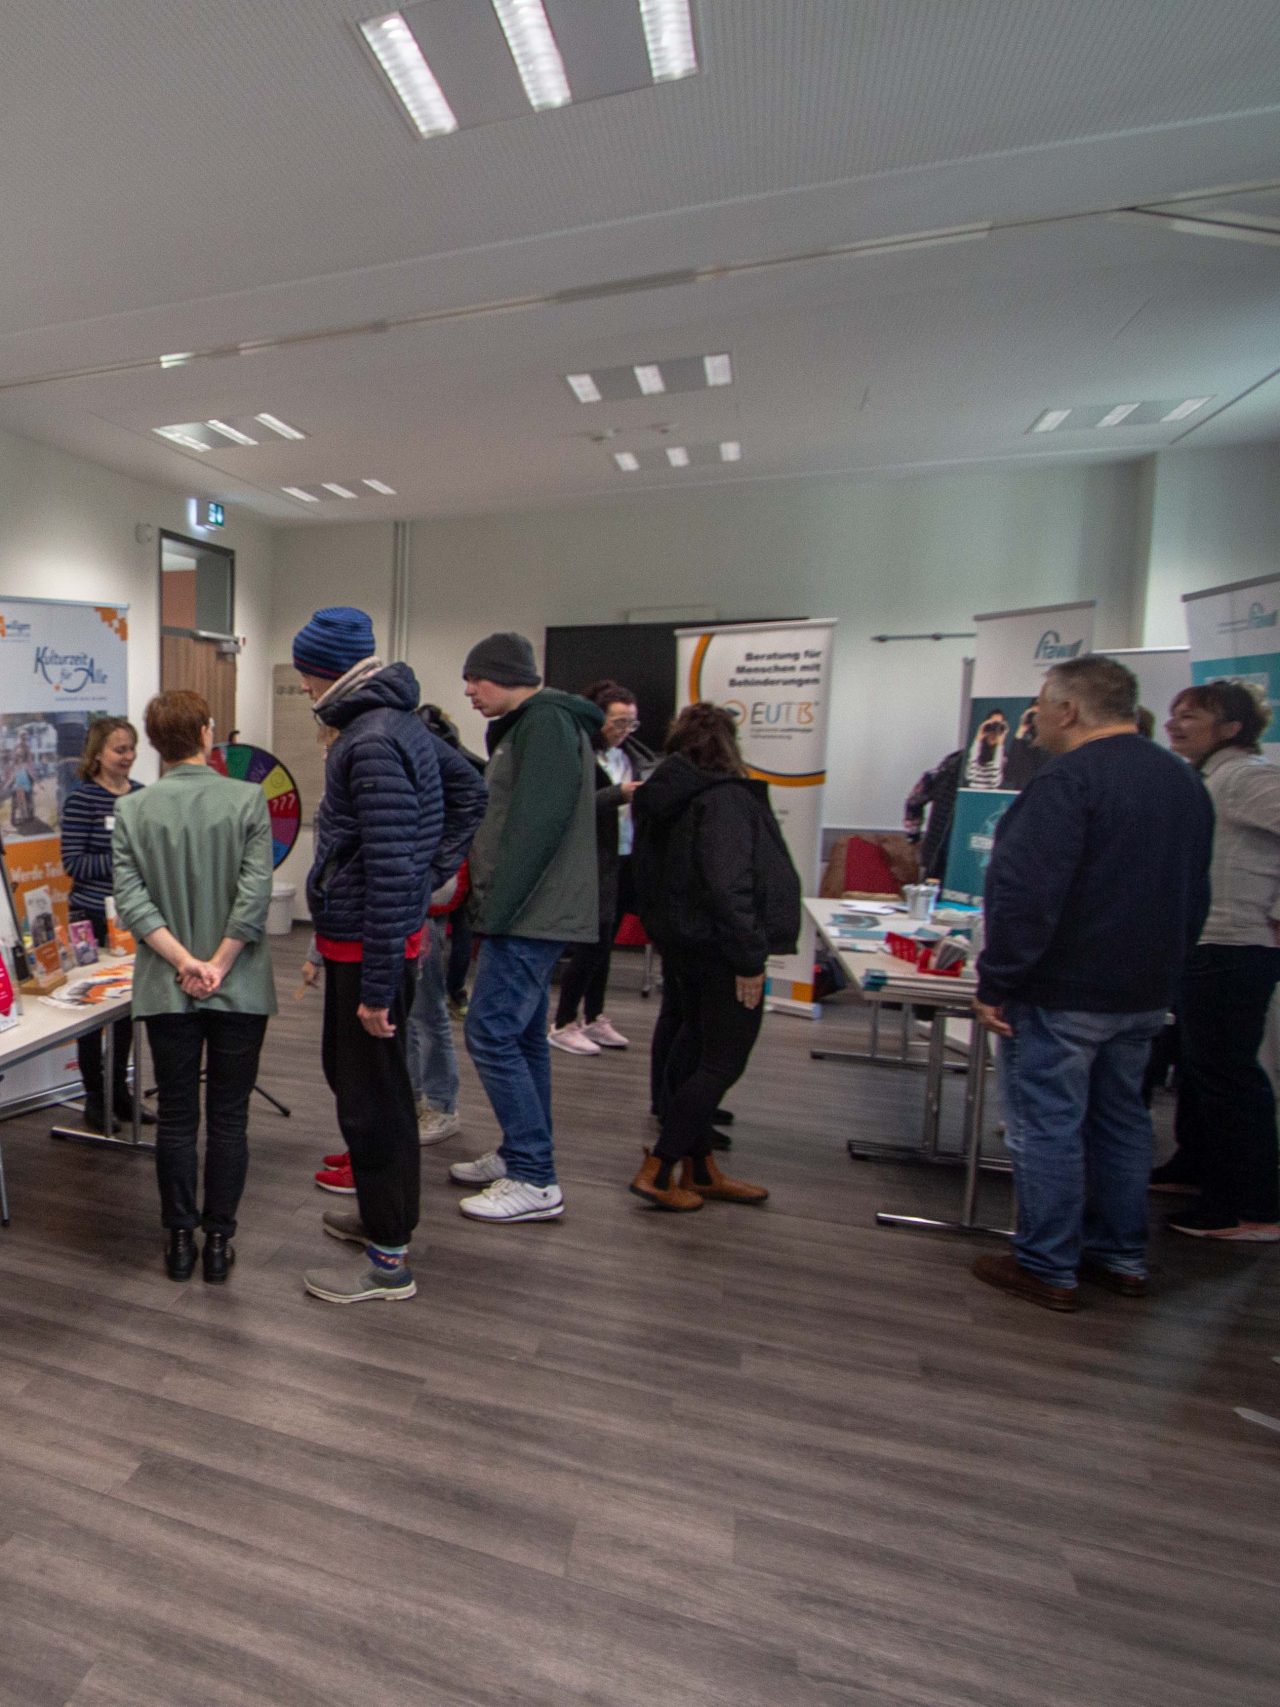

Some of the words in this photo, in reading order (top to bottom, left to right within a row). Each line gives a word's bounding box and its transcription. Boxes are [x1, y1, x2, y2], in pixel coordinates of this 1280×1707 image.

[34, 647, 89, 675] Kulturzeit
[745, 652, 800, 662] Beratung
[804, 649, 822, 658] für
[736, 665, 796, 674] Menschen
[800, 663, 821, 671] mit
[728, 678, 820, 687] Behinderungen
